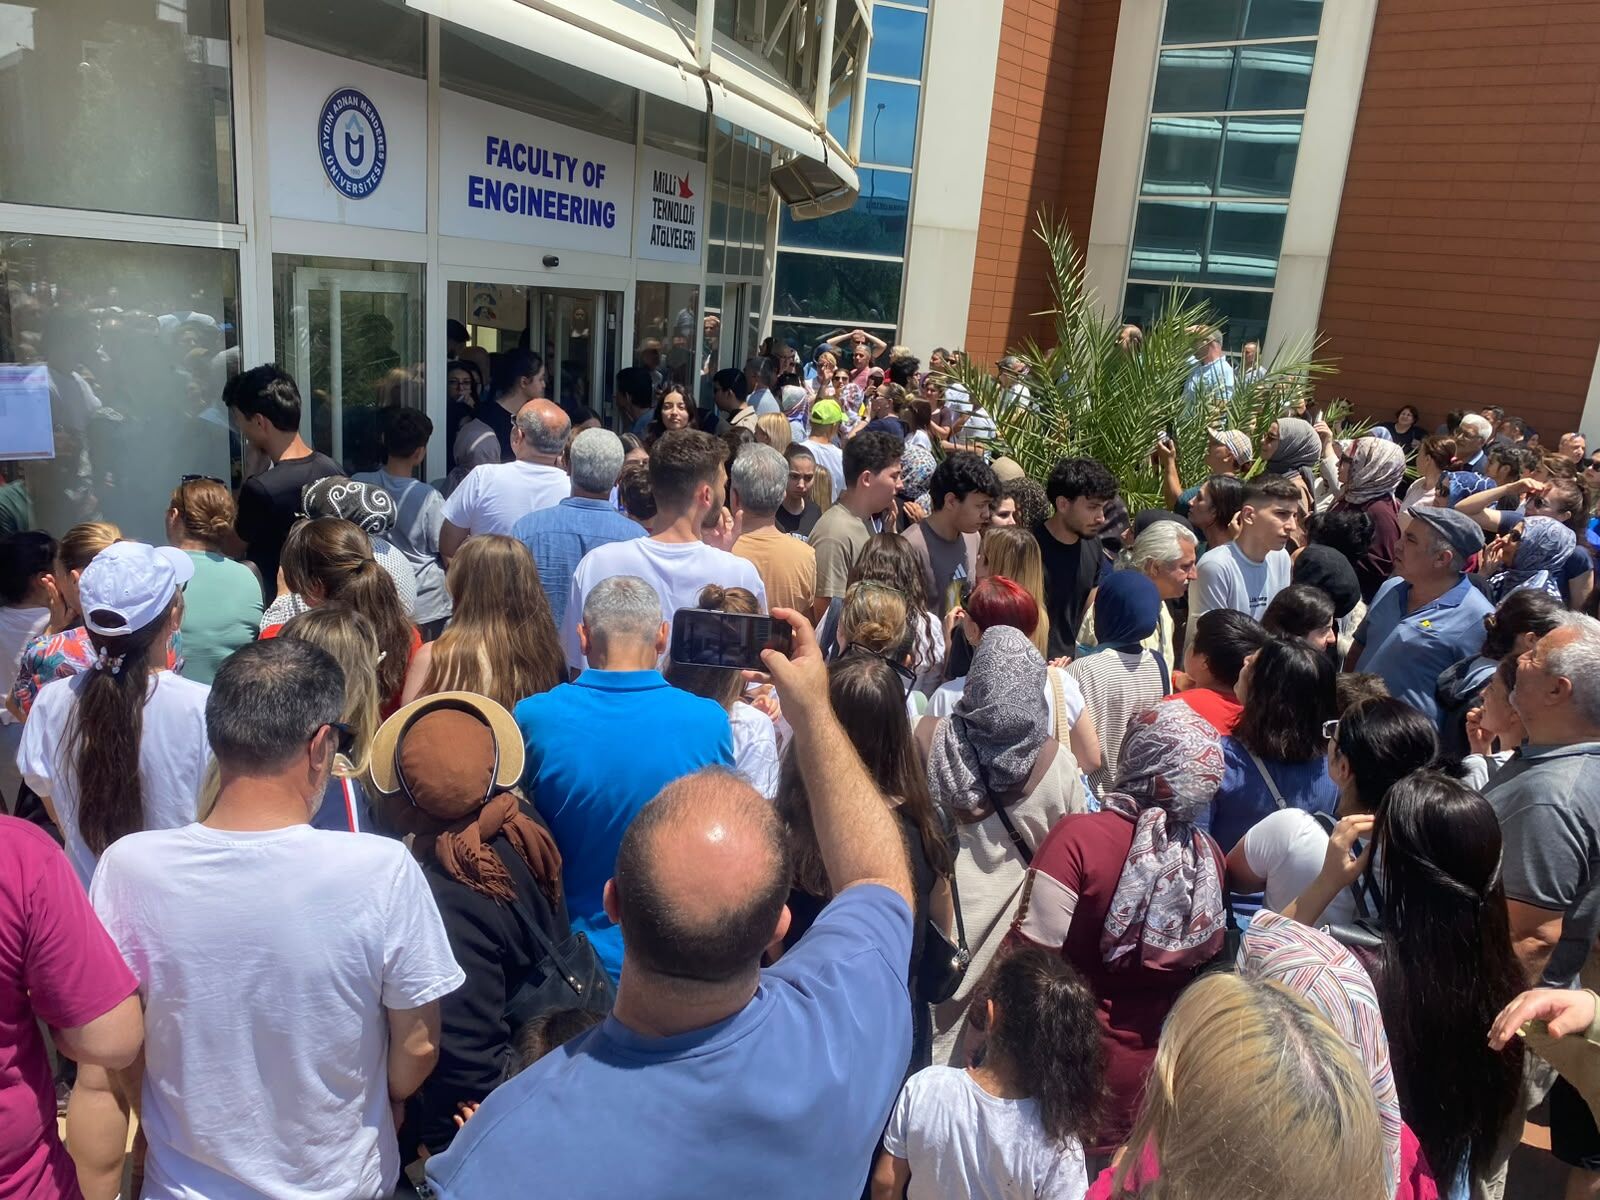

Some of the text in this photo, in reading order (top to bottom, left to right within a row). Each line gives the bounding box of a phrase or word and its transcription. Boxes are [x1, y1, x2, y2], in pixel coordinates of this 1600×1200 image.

[323, 96, 385, 160] AYDIN ADNAN MENDERES
[486, 135, 606, 188] FACULTY OF
[468, 175, 616, 229] ENGINEERING
